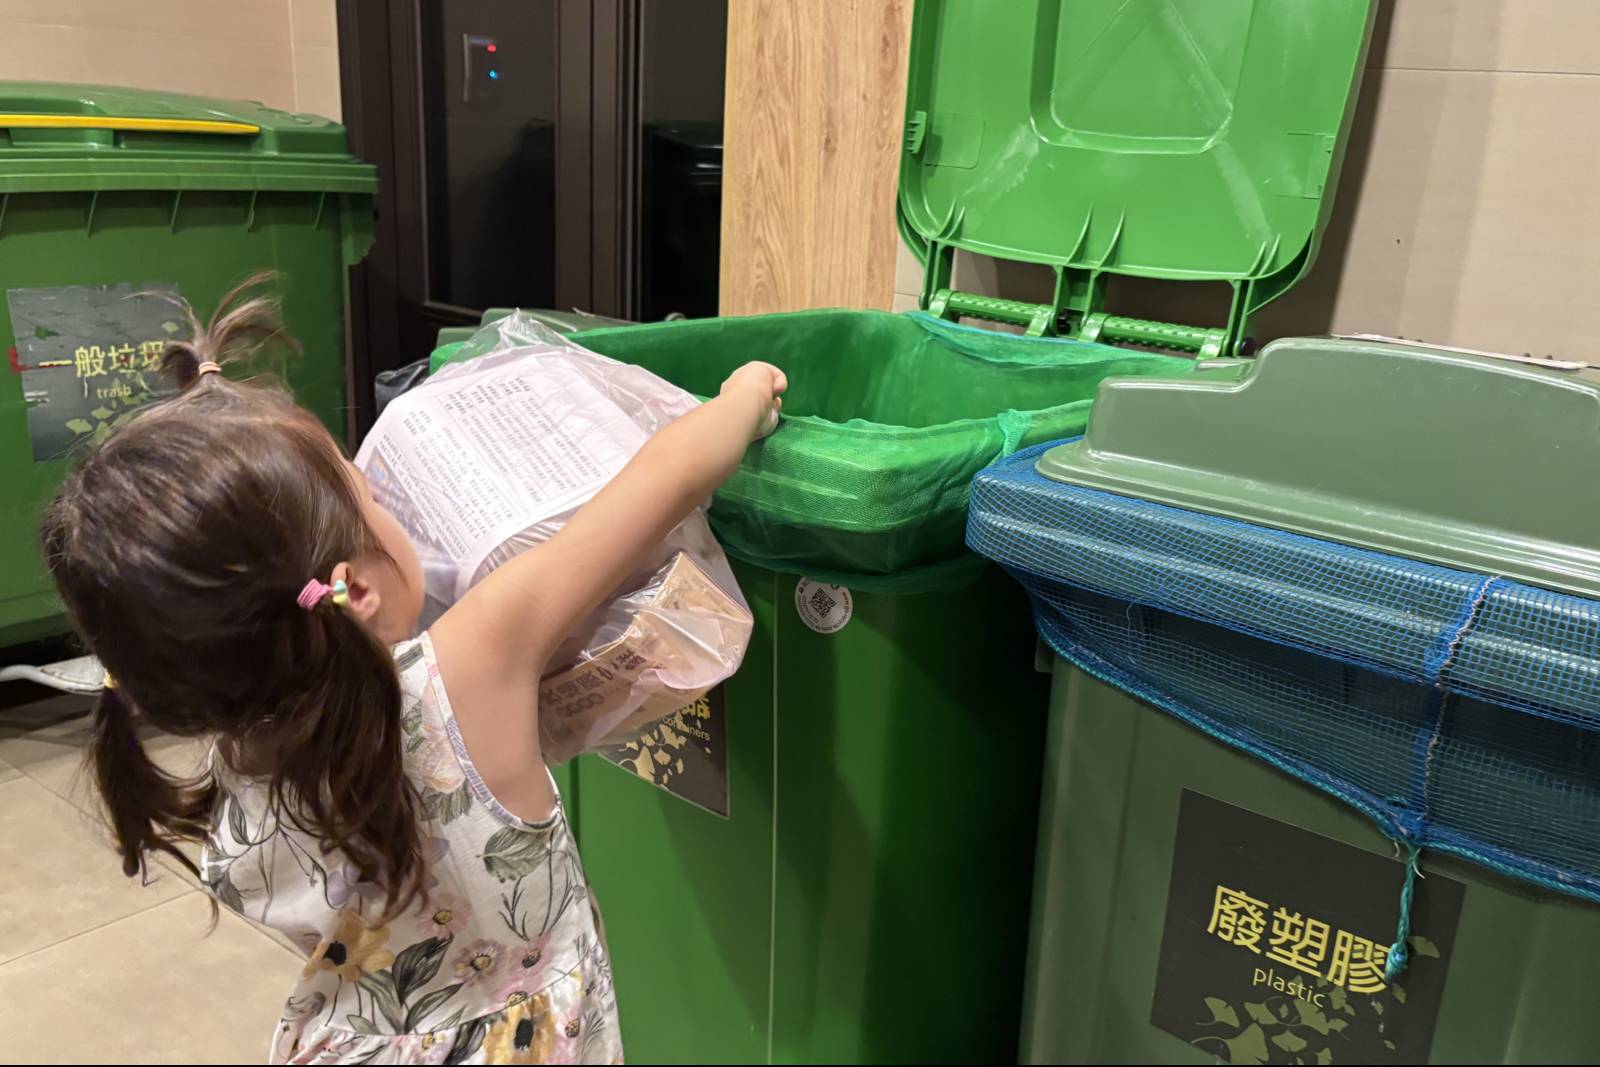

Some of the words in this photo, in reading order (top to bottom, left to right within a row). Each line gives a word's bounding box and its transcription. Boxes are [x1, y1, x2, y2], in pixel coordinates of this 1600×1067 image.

[1207, 884, 1390, 994] 廢塑膠
[1252, 967, 1325, 1009] plastic
